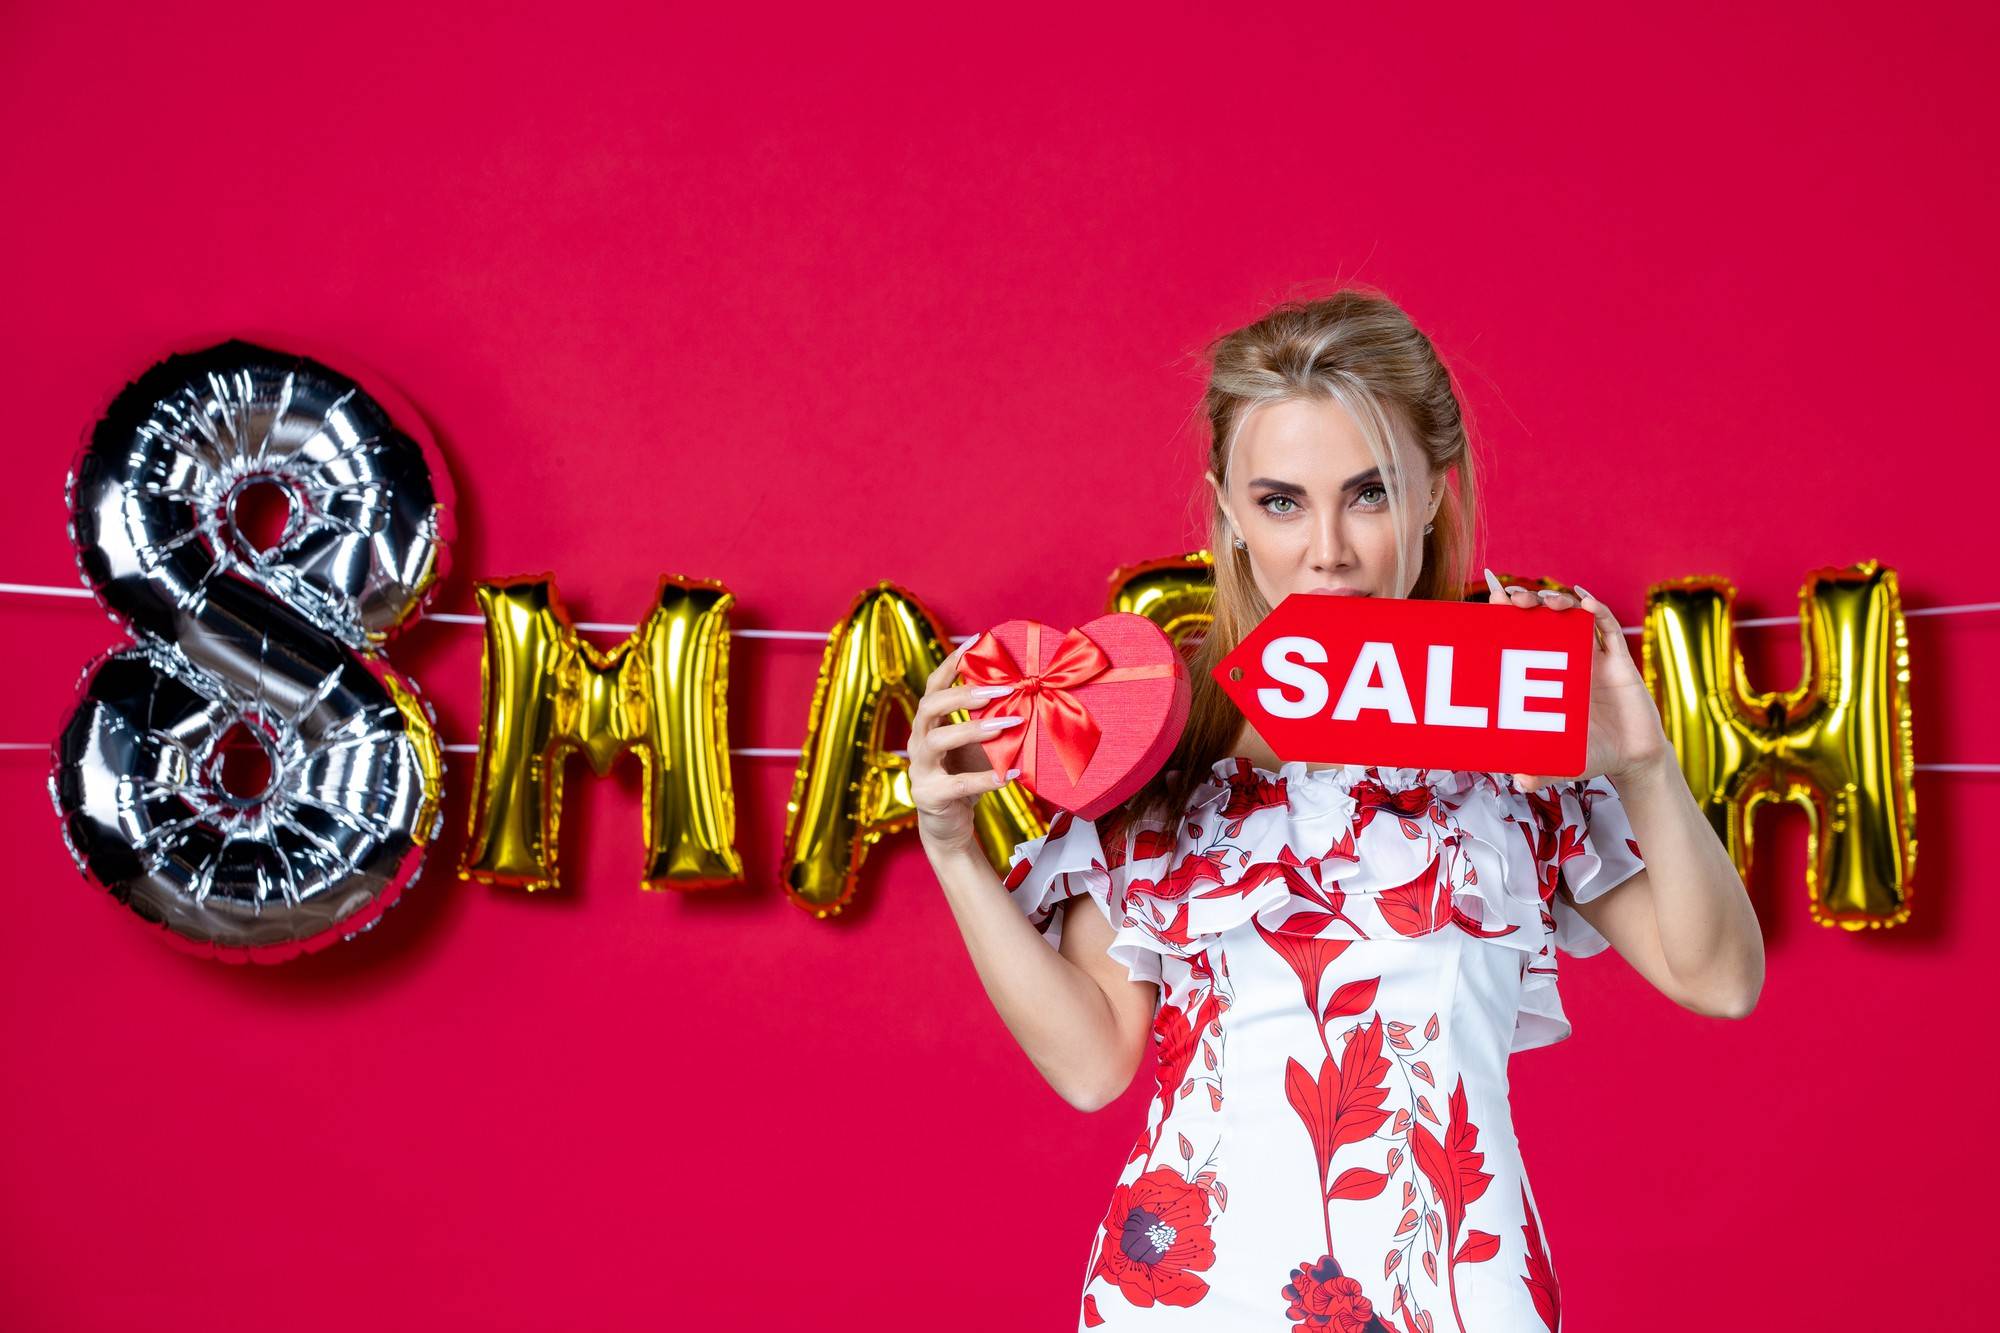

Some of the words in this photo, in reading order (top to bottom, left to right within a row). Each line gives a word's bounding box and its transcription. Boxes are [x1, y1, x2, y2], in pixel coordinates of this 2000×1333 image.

[49, 338, 452, 964] 8
[459, 550, 1917, 931] MAH
[1257, 637, 1569, 732] SALE
